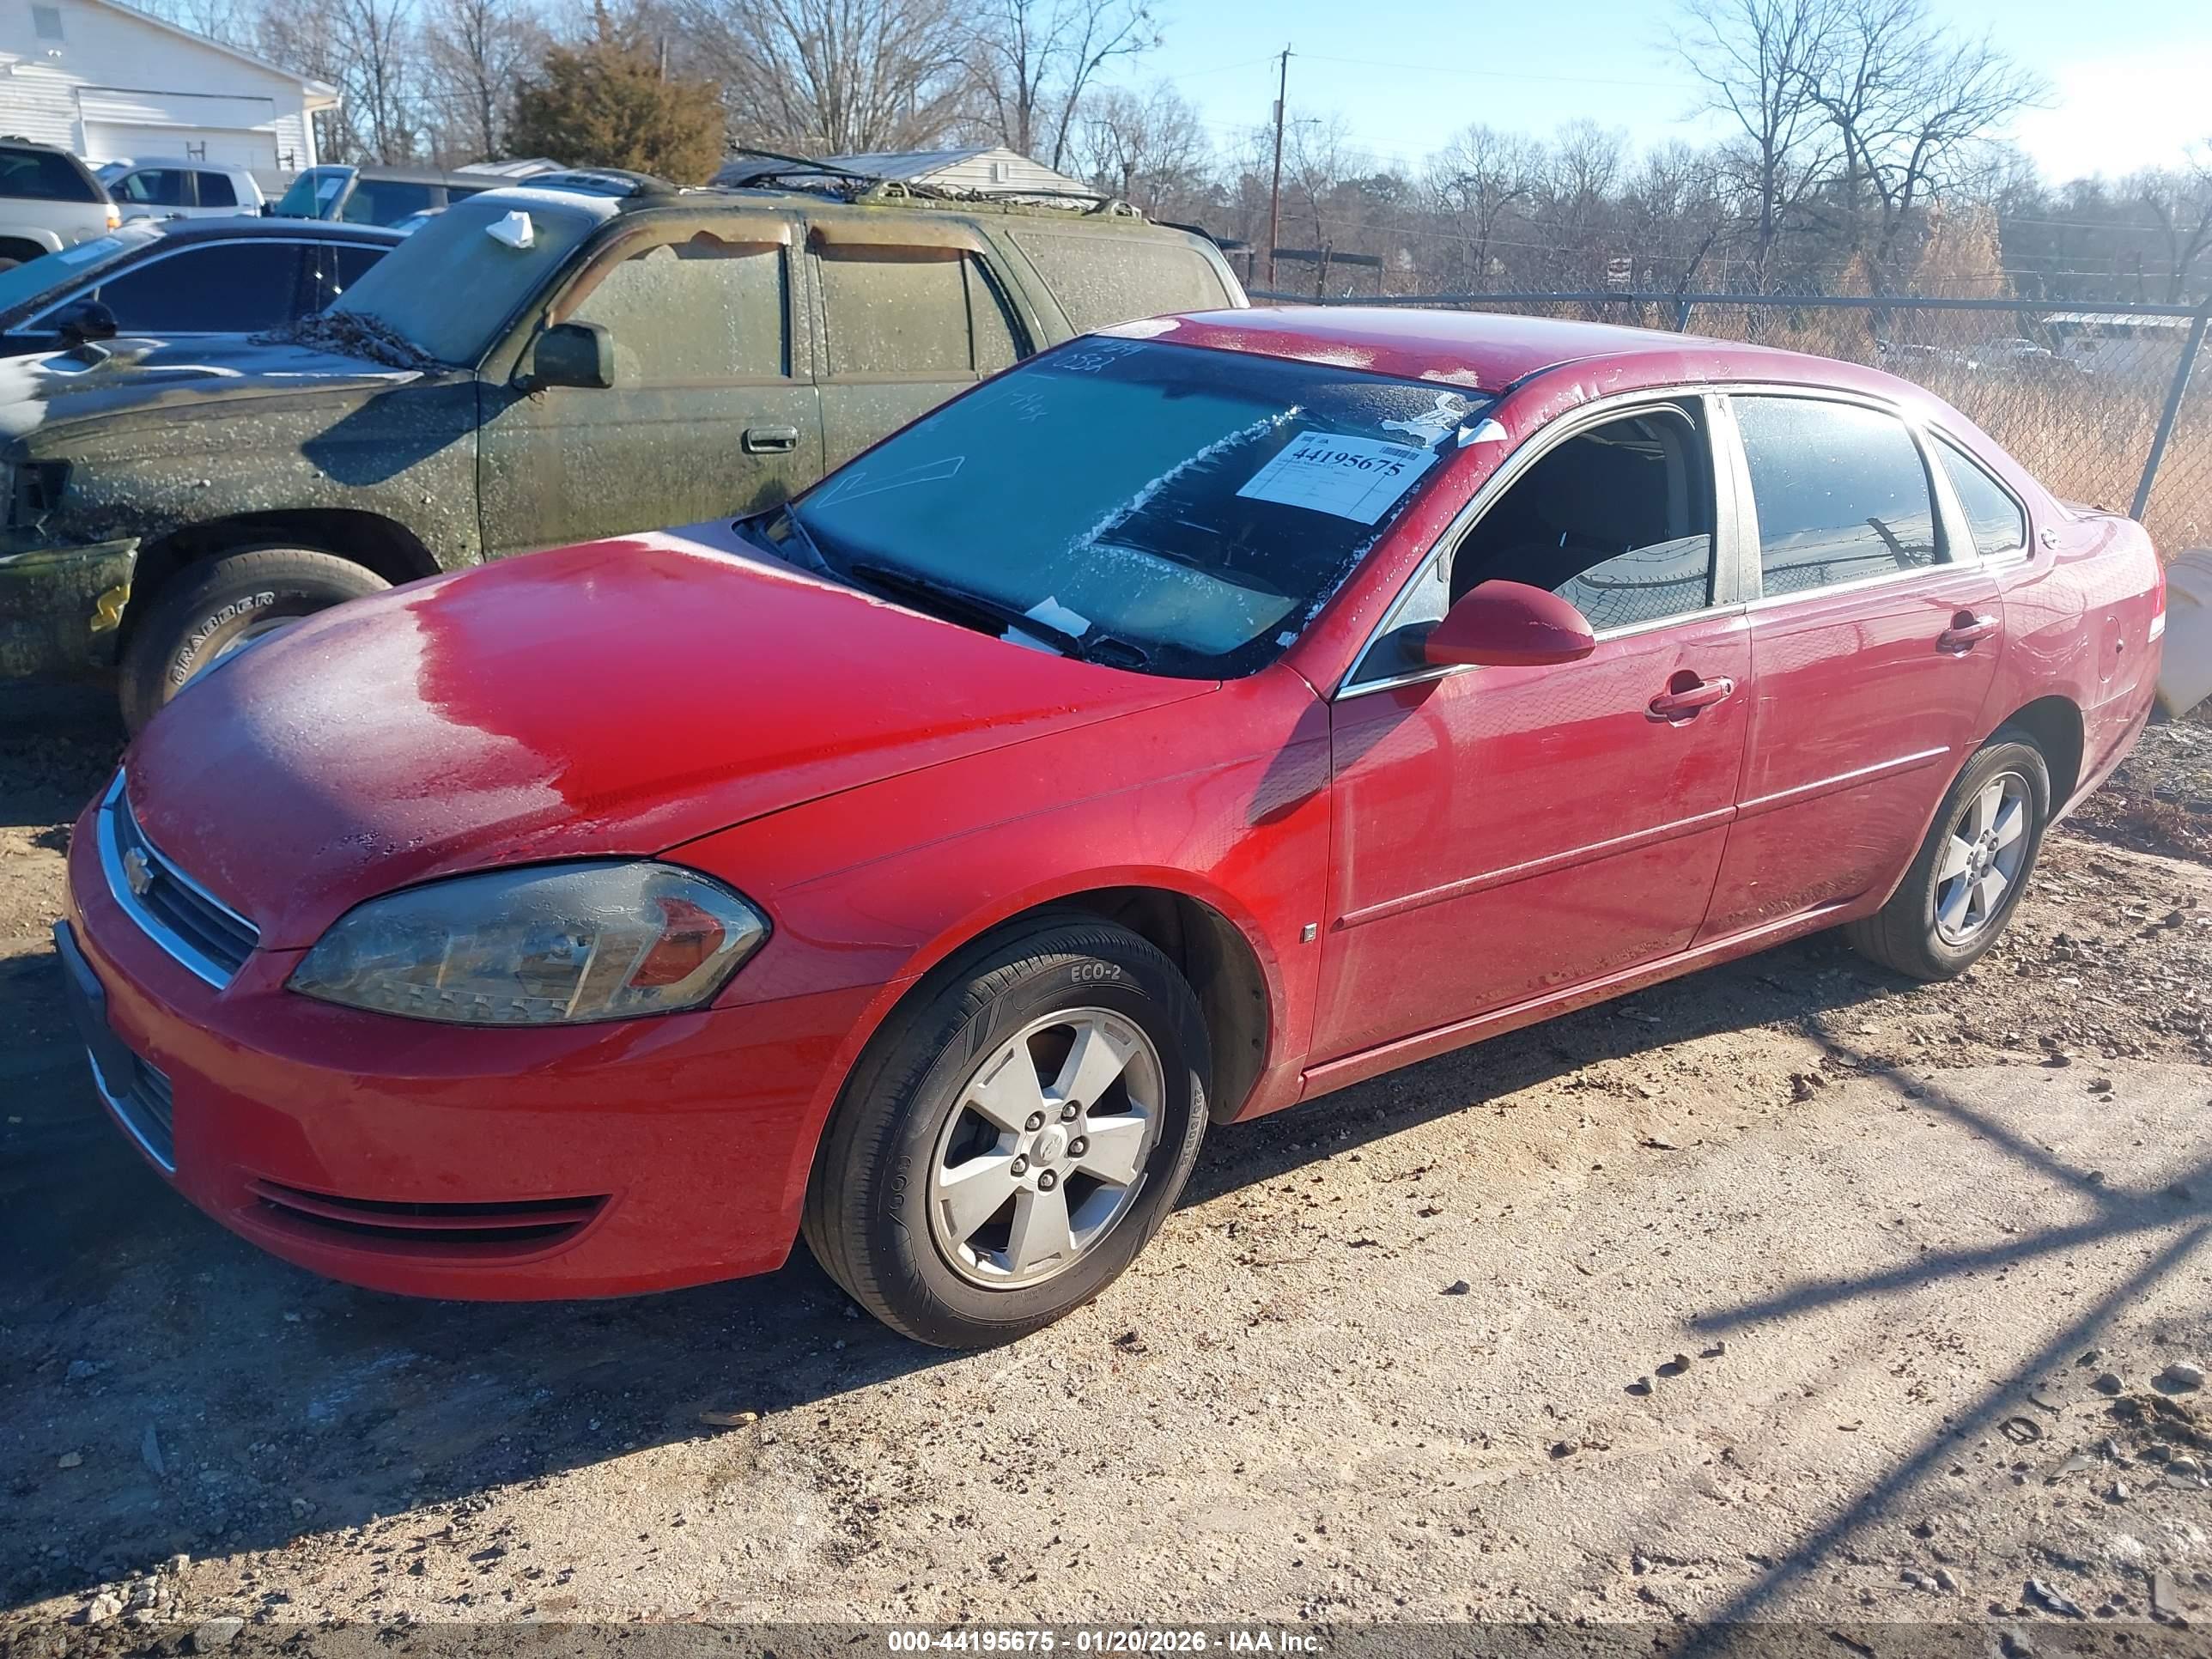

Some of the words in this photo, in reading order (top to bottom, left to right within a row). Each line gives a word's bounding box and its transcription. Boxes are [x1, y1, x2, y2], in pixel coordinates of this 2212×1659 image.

[1292, 447, 1406, 477] 44195675
[171, 591, 276, 686] GRABBER
[1071, 963, 1121, 982] ECO-2
